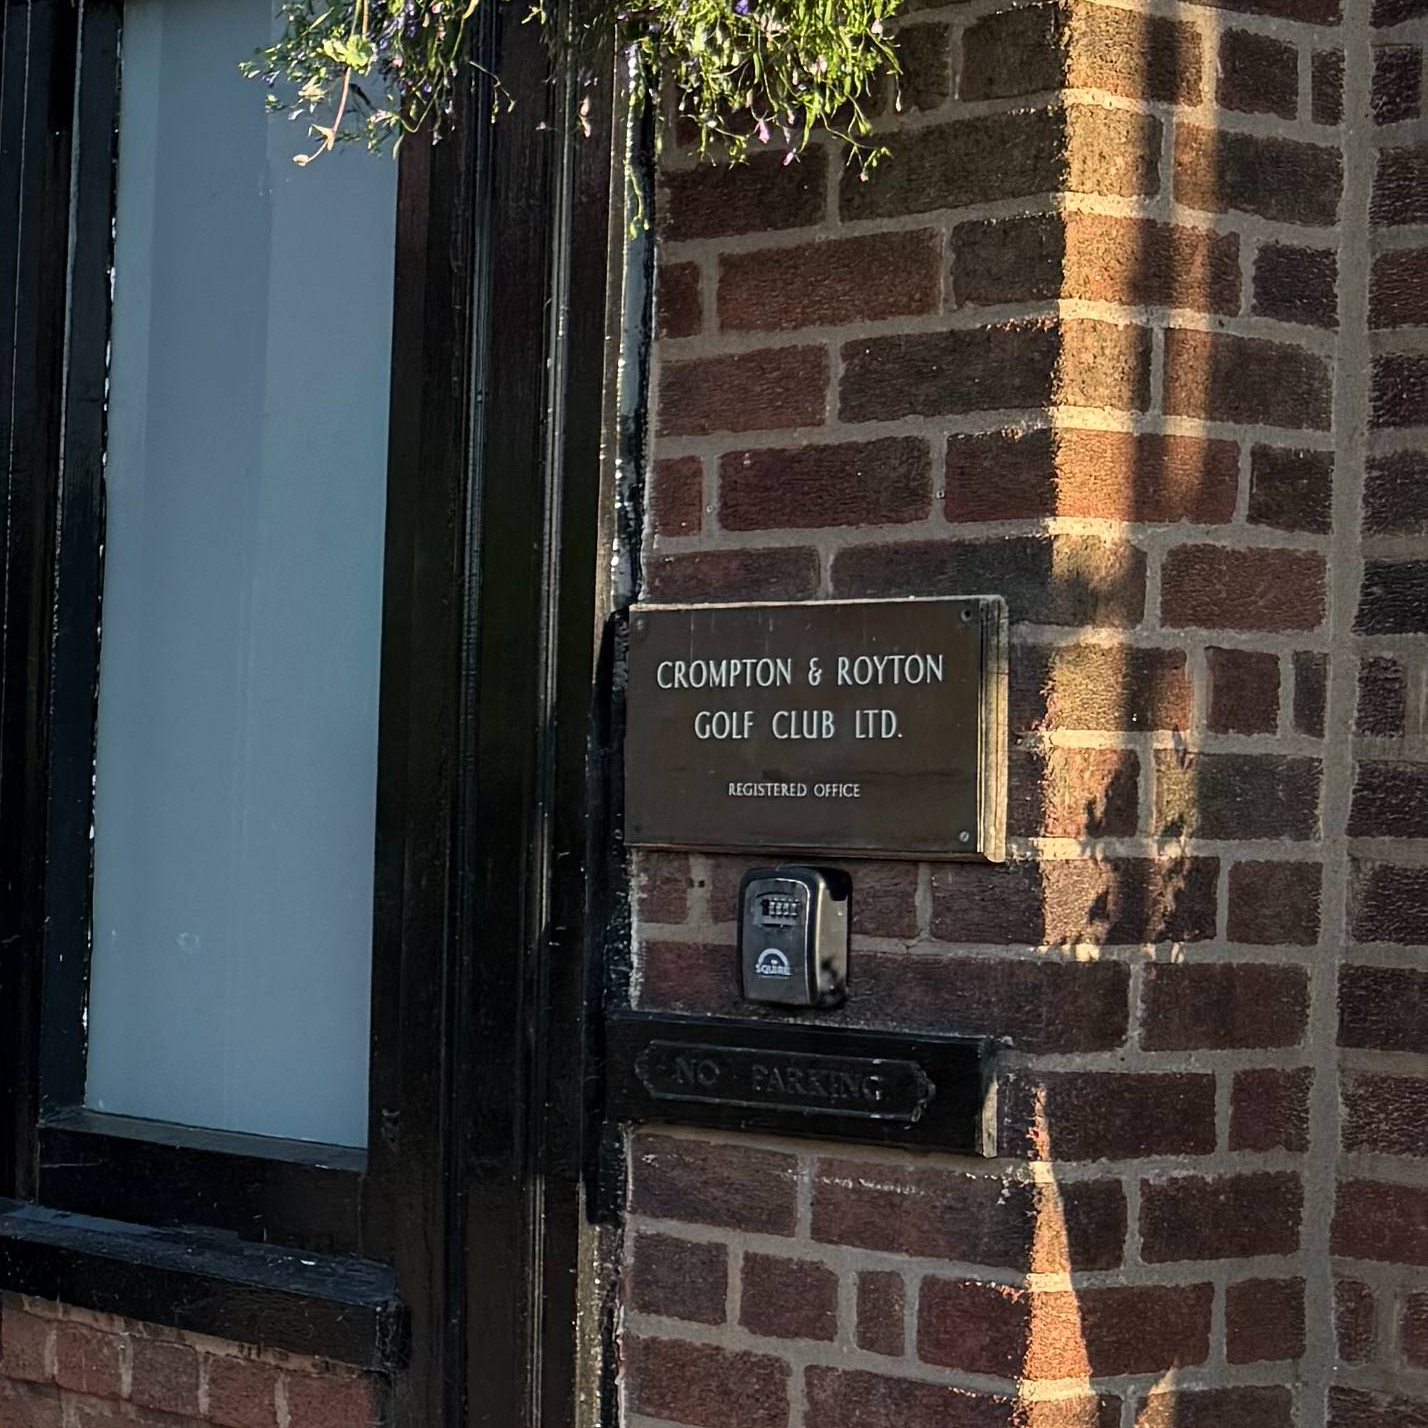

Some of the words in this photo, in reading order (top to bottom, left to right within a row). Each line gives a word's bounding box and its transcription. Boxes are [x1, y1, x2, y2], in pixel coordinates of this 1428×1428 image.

[657, 657, 792, 689] CROMPTON
[808, 657, 822, 686] &
[837, 654, 944, 686] ROYTON
[694, 710, 755, 740] GOLF
[772, 710, 835, 740] CLUB
[855, 710, 903, 740] LTD.
[728, 782, 807, 798] REGISTERED
[814, 783, 861, 798] OFFICE
[676, 1059, 720, 1086] NO
[752, 1063, 884, 1102] PARKING
